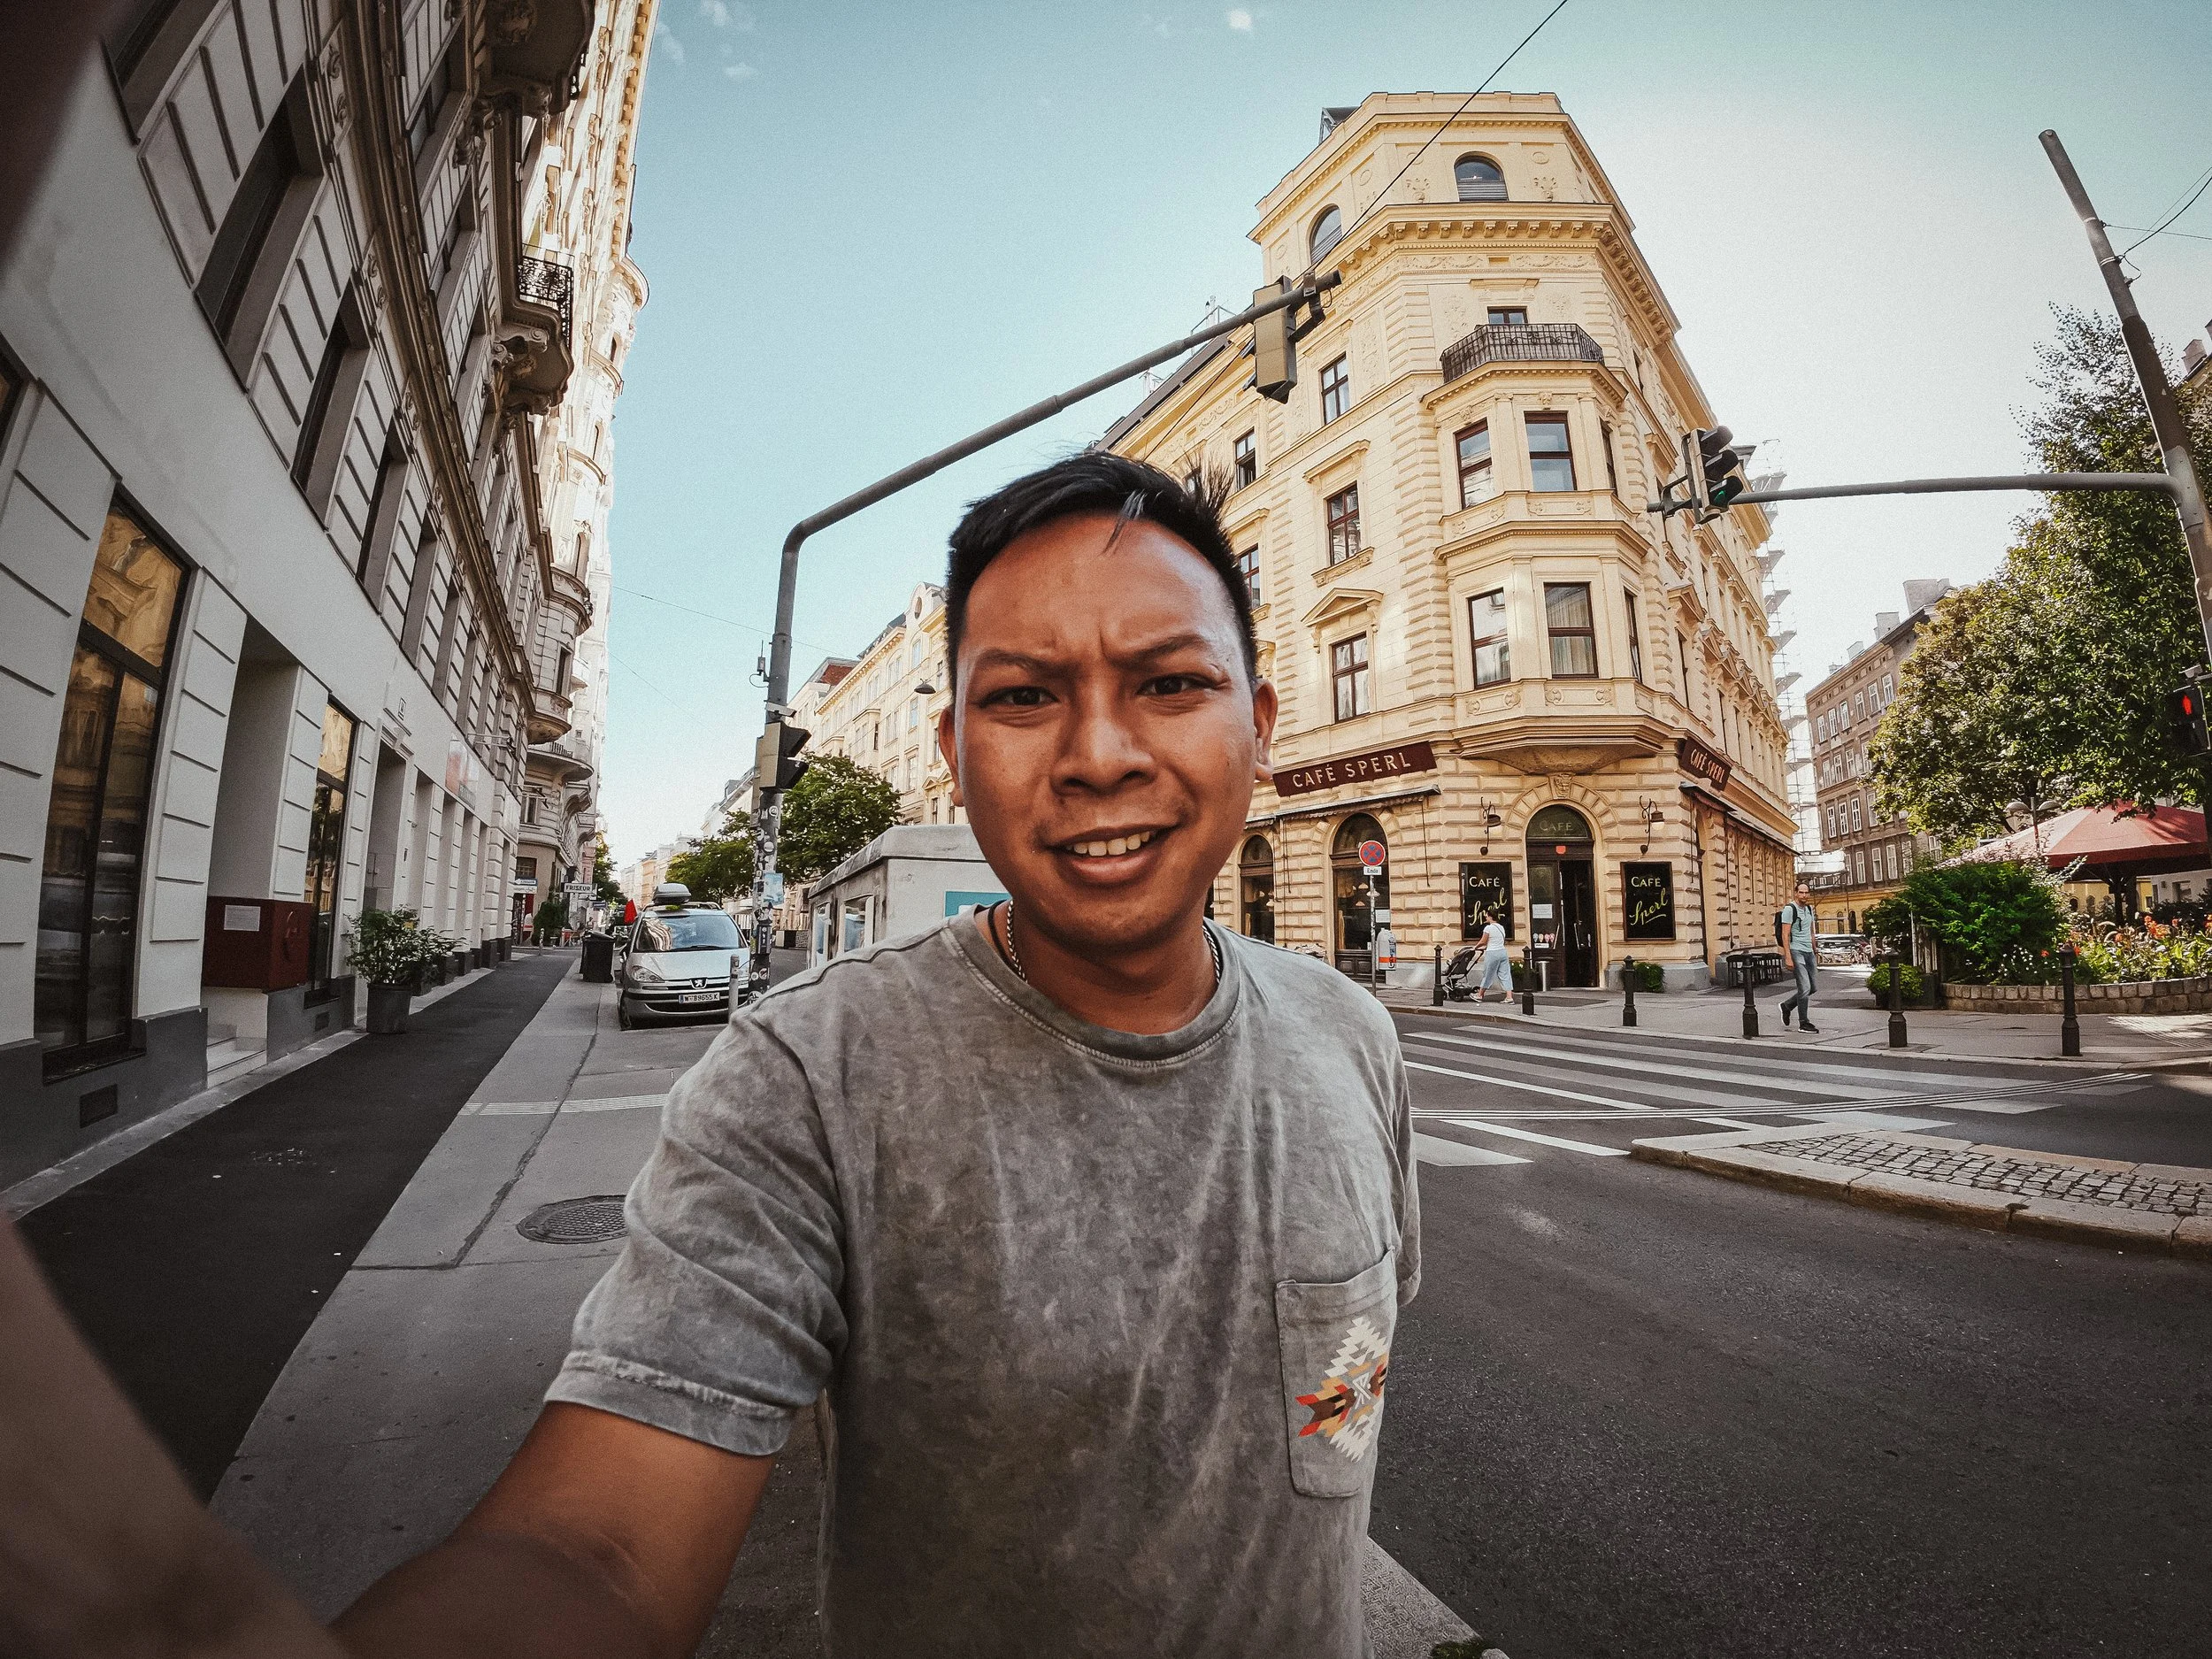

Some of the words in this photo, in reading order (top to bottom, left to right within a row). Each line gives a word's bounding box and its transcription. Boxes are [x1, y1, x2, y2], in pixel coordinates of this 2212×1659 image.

[1292, 764, 1336, 788] CAFÉ
[1344, 752, 1411, 778] SPERL
[1690, 749, 1708, 772] CAFÉ
[1469, 876, 1501, 887] CAFÉ
[1631, 876, 1662, 887] CAFÉ
[1629, 887, 1669, 926] Sperl
